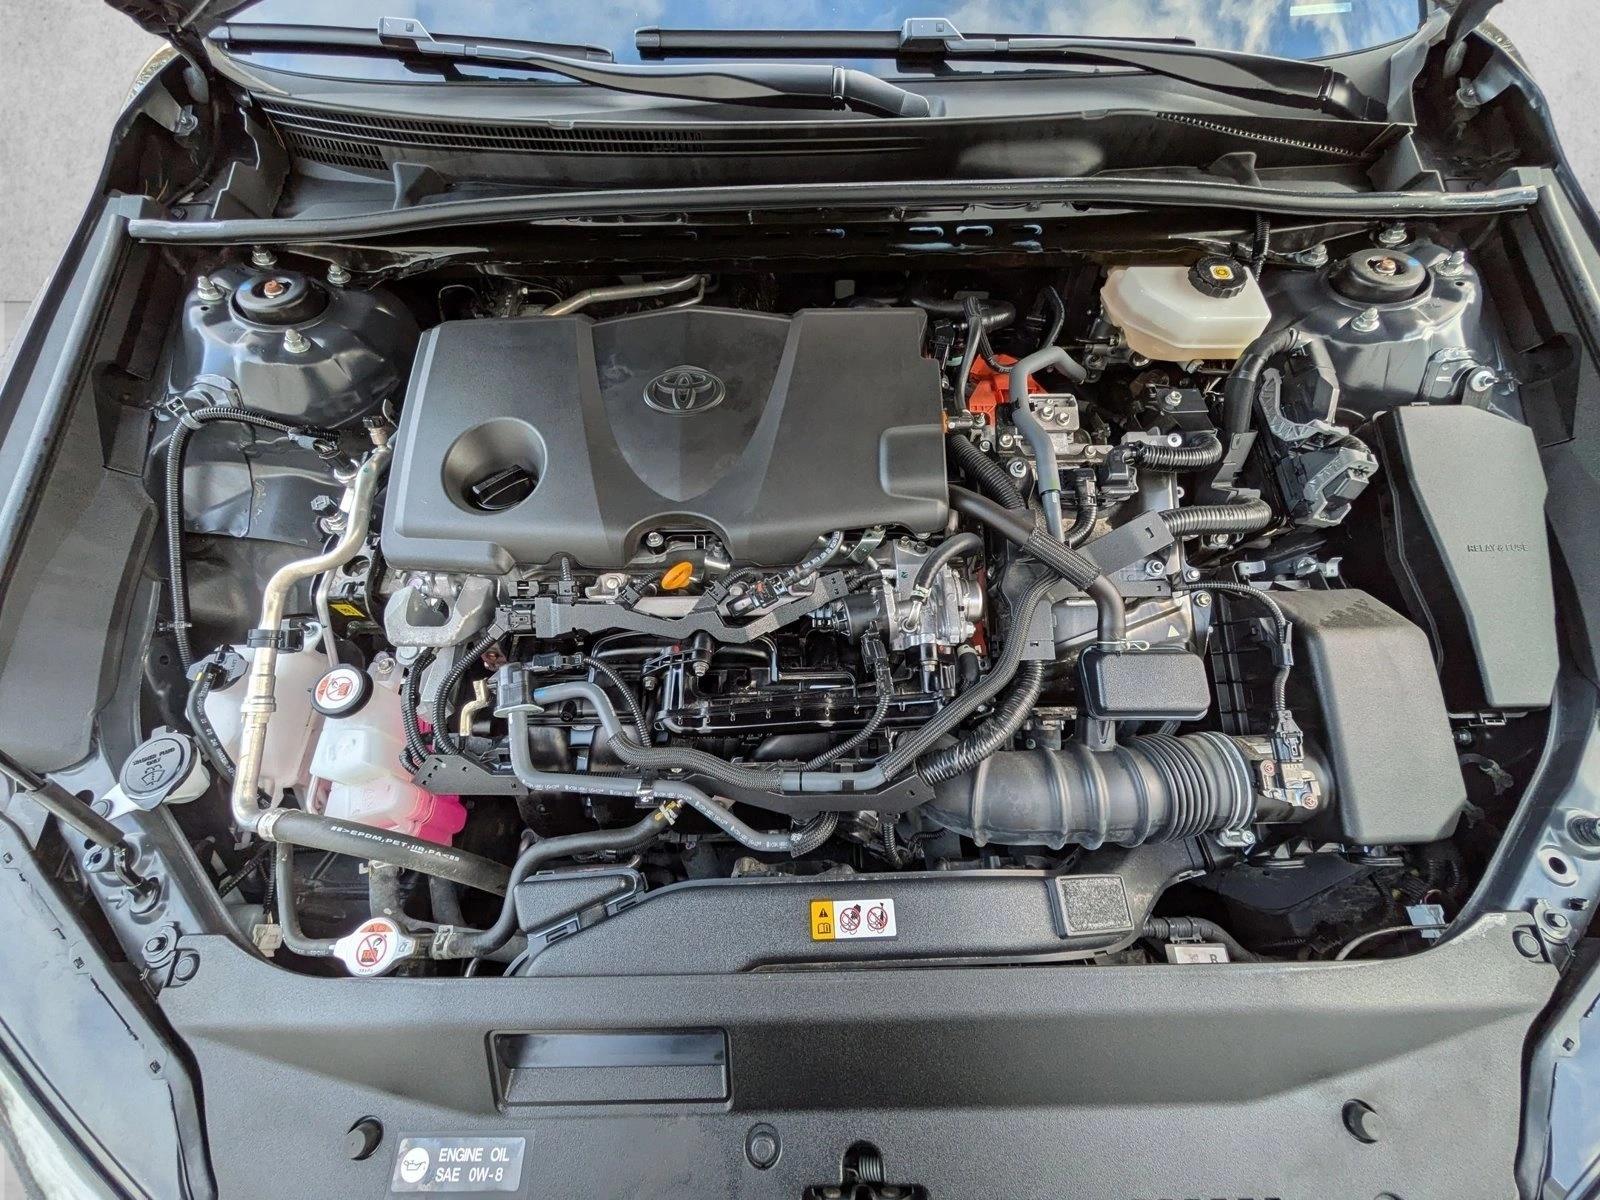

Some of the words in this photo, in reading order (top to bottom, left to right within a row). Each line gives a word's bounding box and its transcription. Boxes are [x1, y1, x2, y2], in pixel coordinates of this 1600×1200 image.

[1466, 544, 1495, 553] RELAY
[1505, 543, 1529, 552] FUSE
[438, 1147, 484, 1162] ENGINE
[490, 1147, 510, 1162] OIL
[435, 1167, 461, 1182] SAE
[468, 1167, 504, 1182] 0W-8
